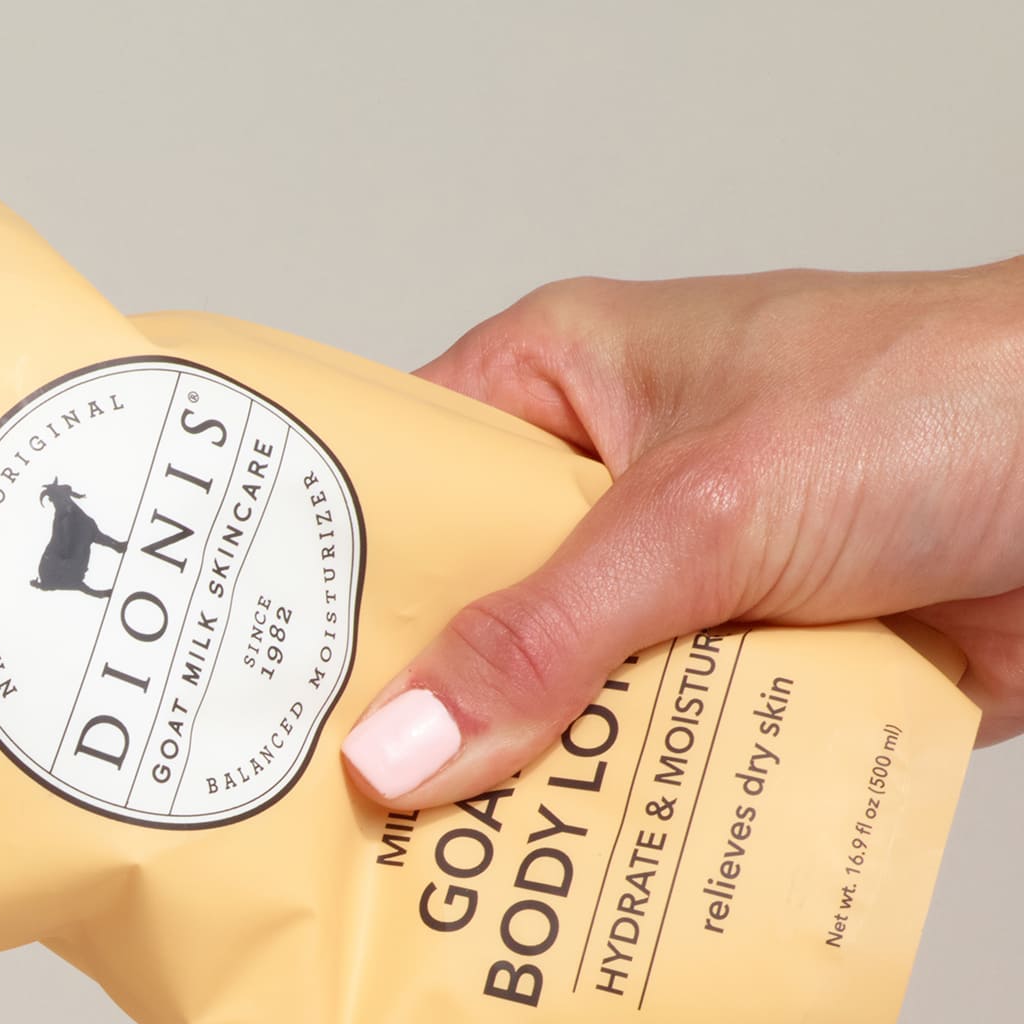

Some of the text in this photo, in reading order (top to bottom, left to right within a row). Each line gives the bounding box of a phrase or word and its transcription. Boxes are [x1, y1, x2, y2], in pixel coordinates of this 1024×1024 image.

[151, 438, 274, 784] GOAT MILK SKINCARE
[205, 470, 338, 795] BALANCED MOISTURIZER
[243, 594, 272, 669] SINCE
[260, 605, 293, 681] 1982
[375, 809, 421, 868] MIL
[418, 769, 522, 933] GOA
[482, 803, 589, 1009] BODY
[594, 627, 724, 997] HYDRATE & MOISTUR
[702, 676, 795, 935] relieves dry skin
[824, 723, 904, 949] Net wt. 16.9 fl oz (500 ml)
